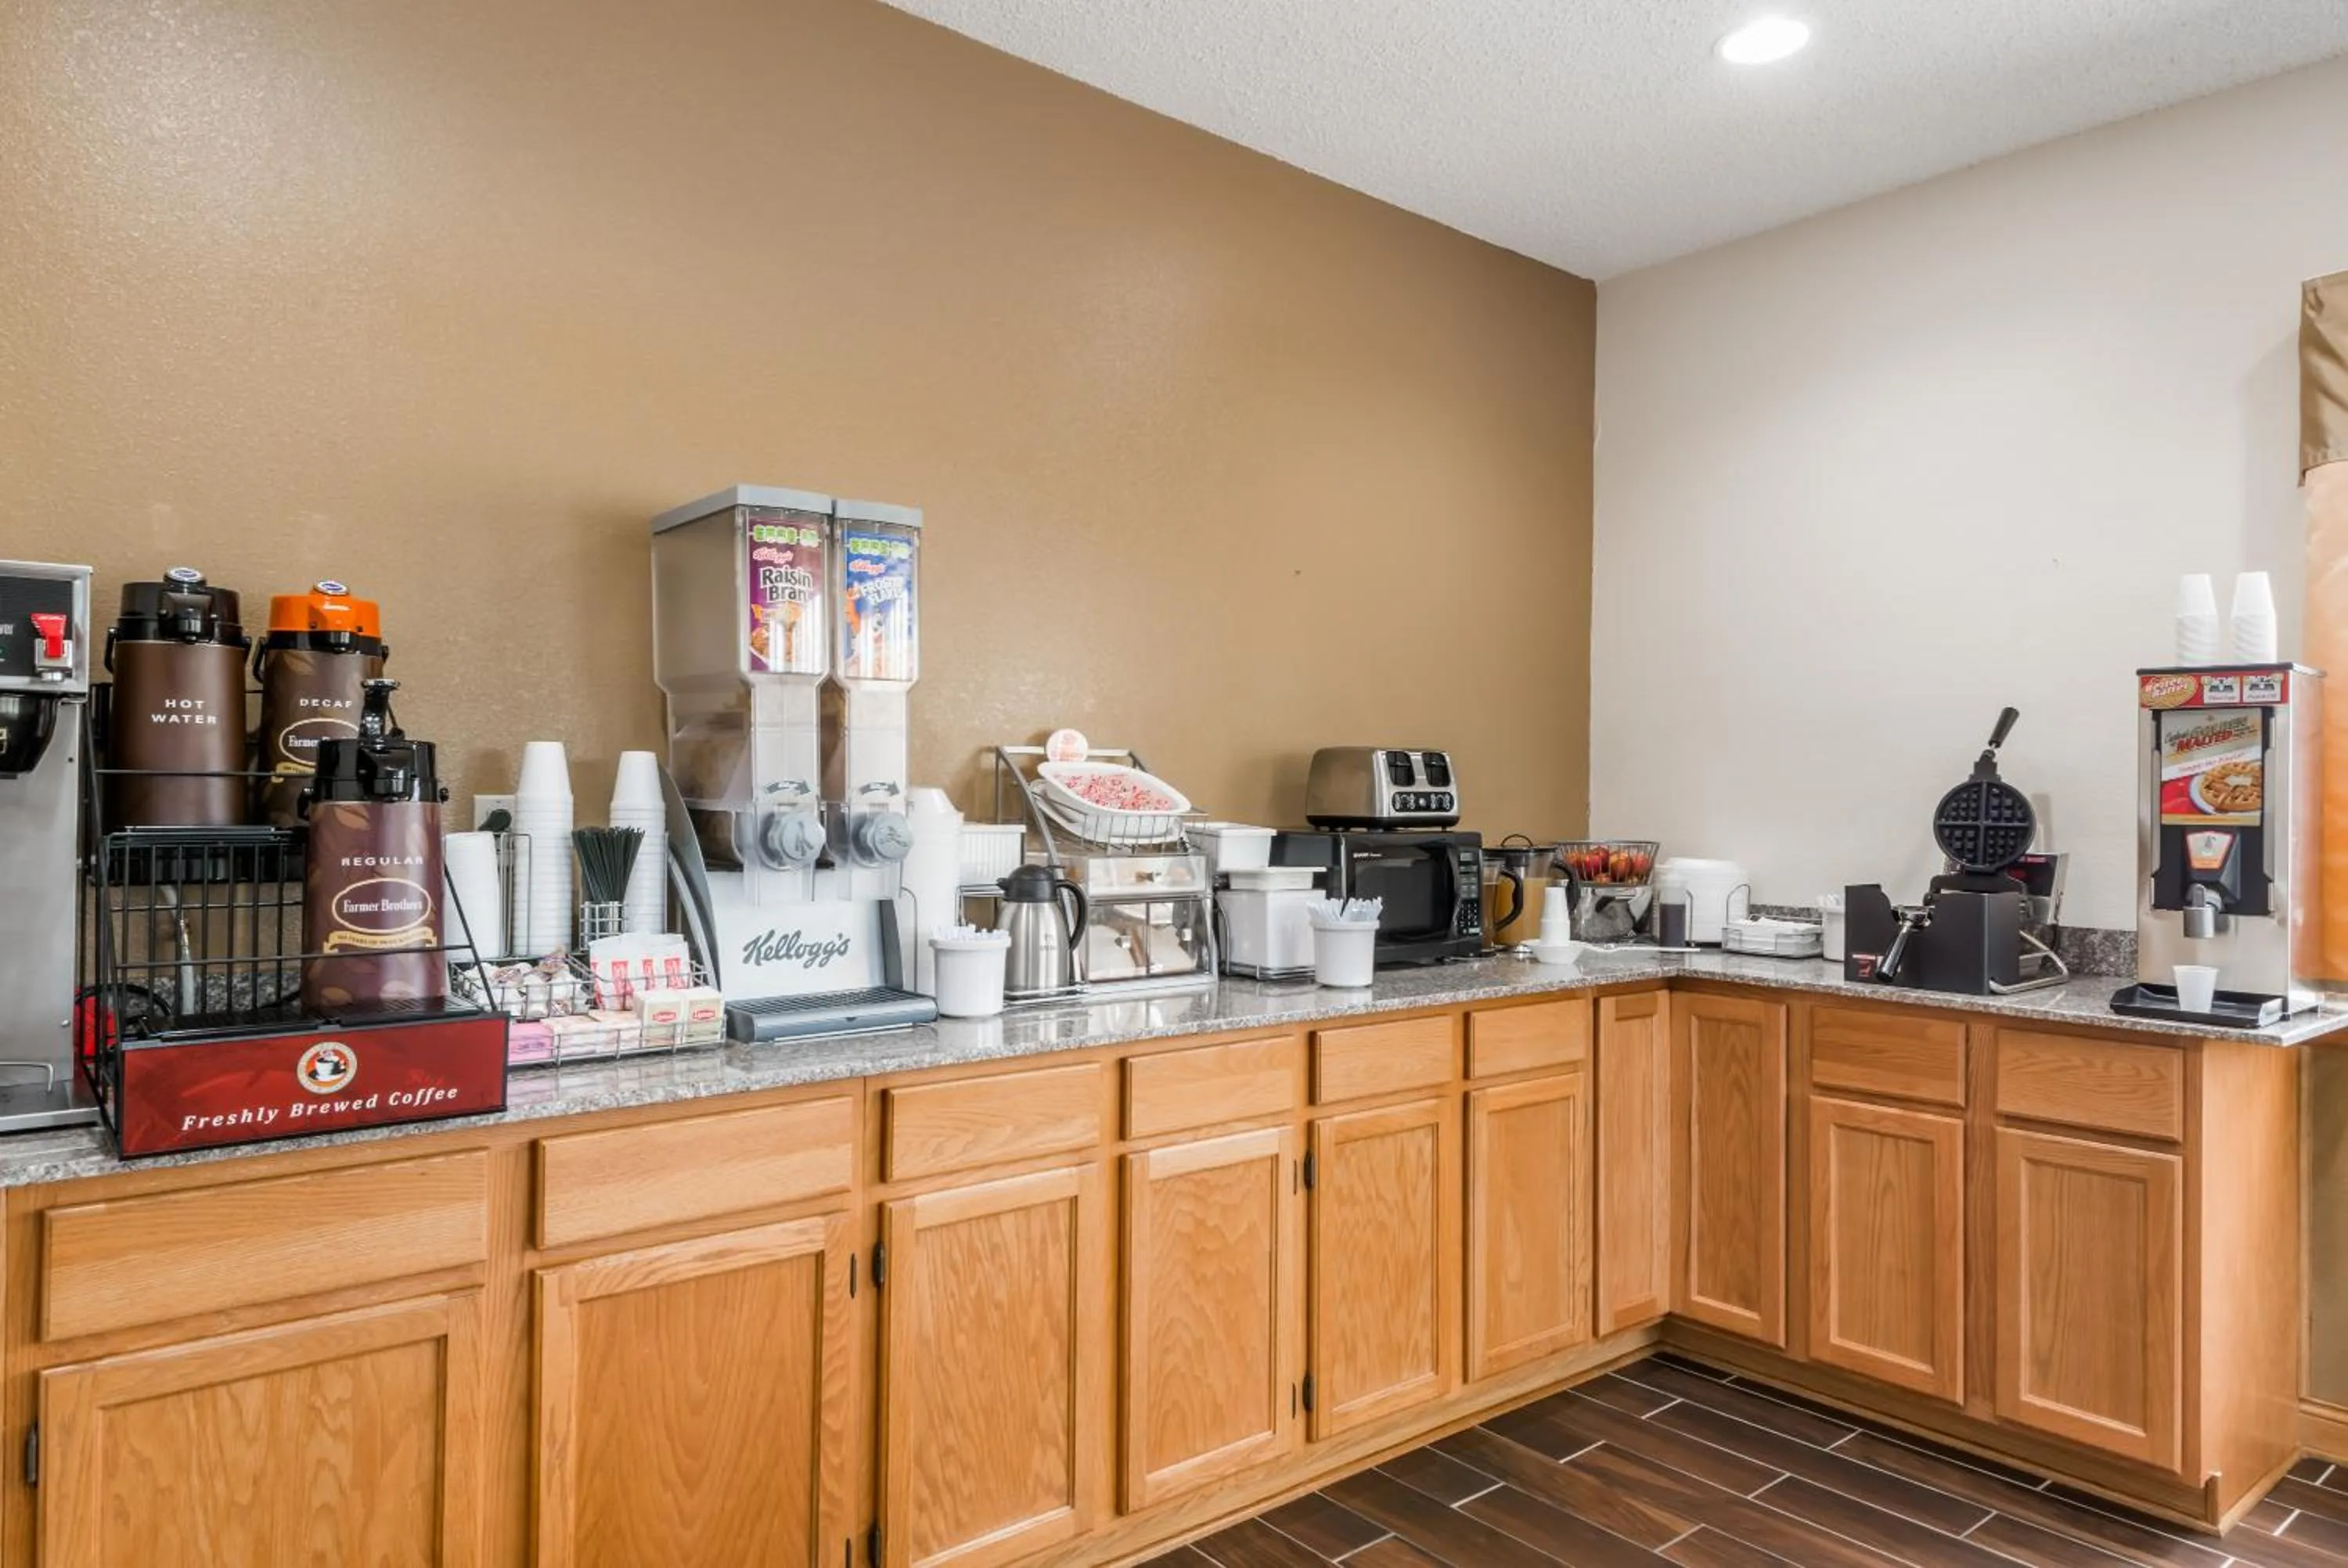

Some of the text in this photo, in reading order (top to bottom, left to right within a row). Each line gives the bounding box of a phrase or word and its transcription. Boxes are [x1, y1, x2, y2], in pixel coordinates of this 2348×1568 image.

[762, 565, 812, 588] Raisin
[769, 585, 807, 601] Bran
[165, 699, 205, 709] HOT
[300, 699, 353, 707] DECAF
[151, 714, 217, 725] WATER
[340, 856, 424, 866] REGULAR
[343, 898, 423, 913] Farmer Brothers
[743, 929, 851, 969] Kellogg's
[182, 1087, 459, 1131] Freshly Brewed Coffee
